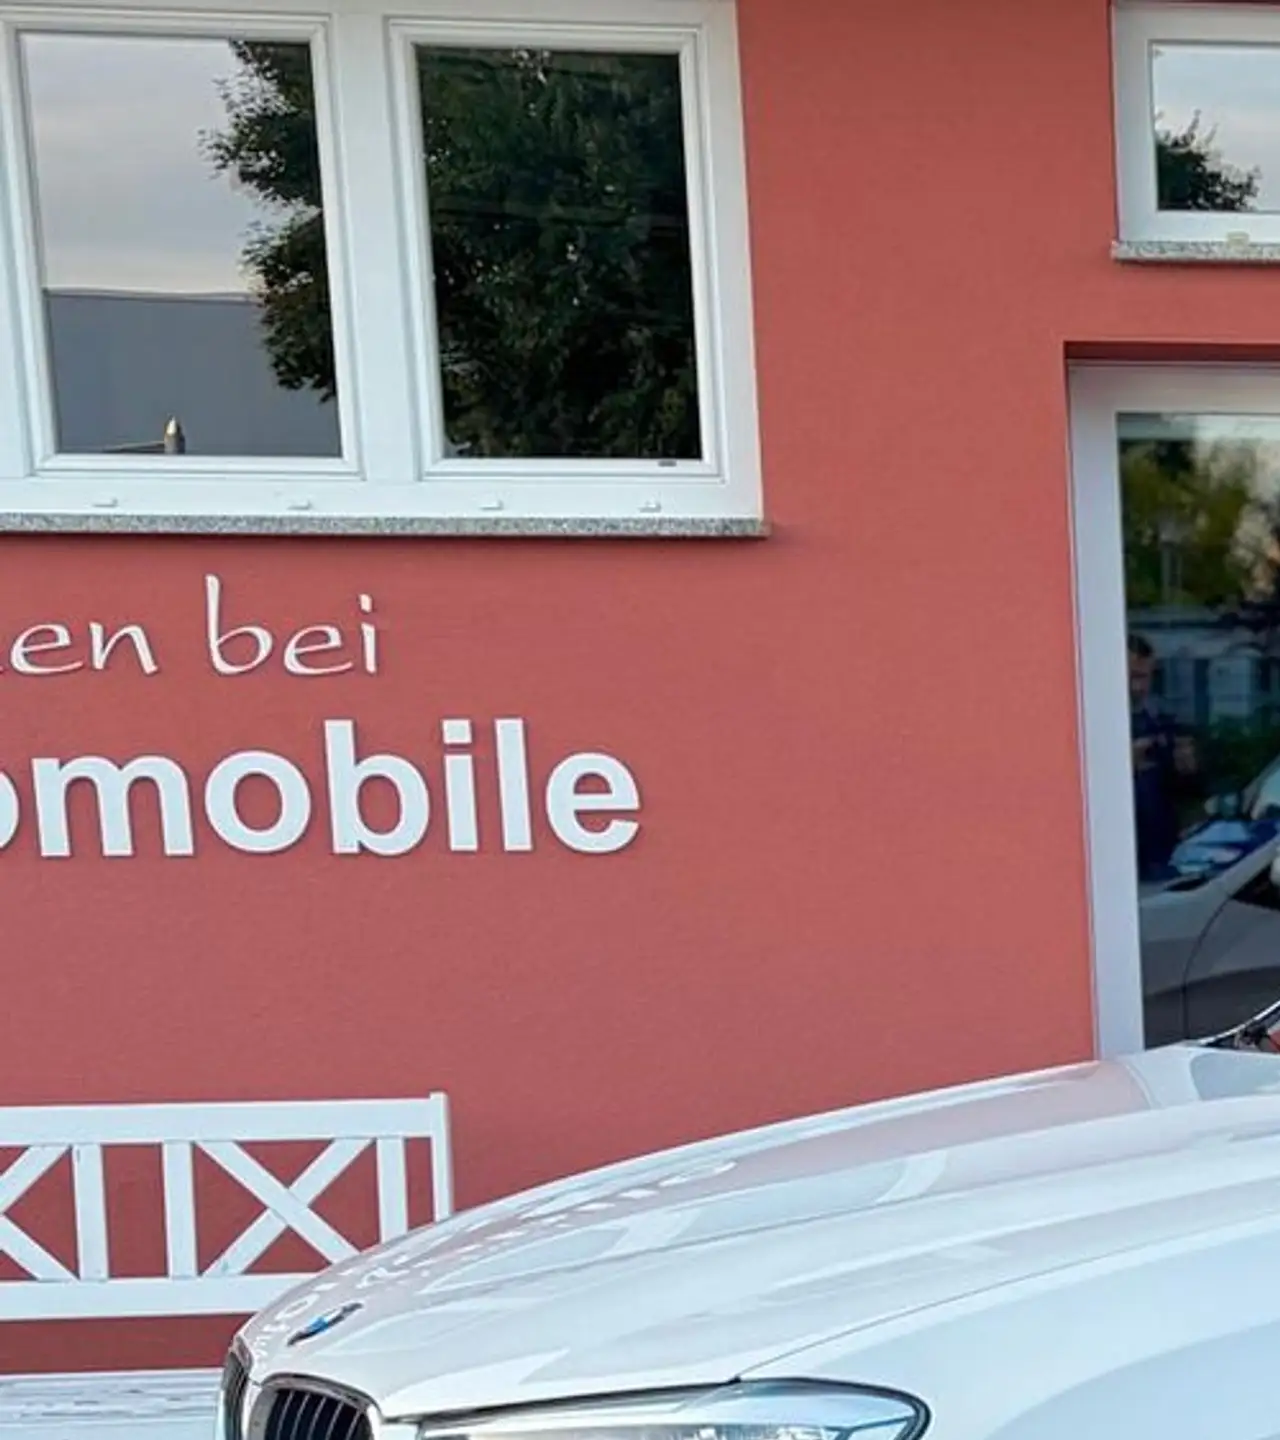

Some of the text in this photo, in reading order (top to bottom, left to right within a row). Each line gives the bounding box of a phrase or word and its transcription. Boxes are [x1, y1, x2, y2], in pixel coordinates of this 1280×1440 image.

[0, 574, 377, 674] en bei
[0, 718, 640, 857] mobile
